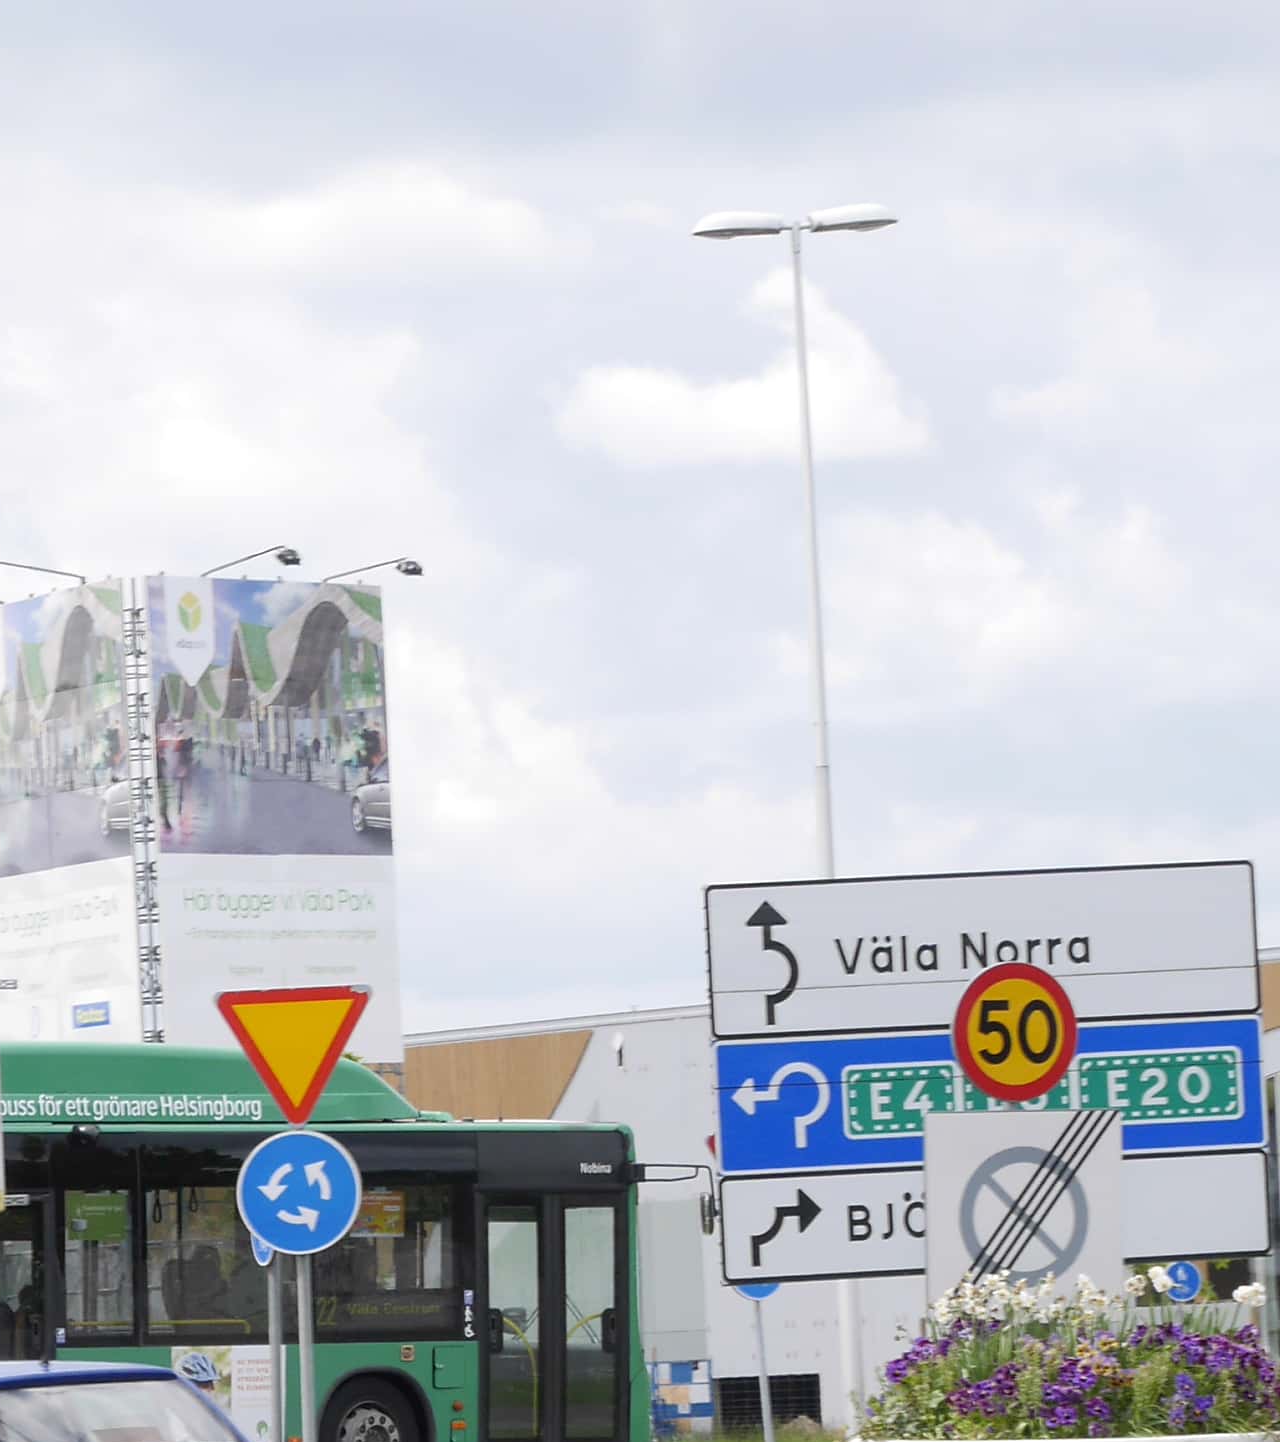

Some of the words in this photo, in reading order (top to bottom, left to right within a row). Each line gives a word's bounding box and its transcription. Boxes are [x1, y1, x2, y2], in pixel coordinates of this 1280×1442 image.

[216, 888, 277, 918] bygger
[338, 888, 376, 911] Park
[834, 935, 939, 975] Väla
[960, 931, 1090, 969] Norra
[978, 999, 1057, 1065] 50
[38, 1094, 61, 1117] för
[65, 1097, 90, 1117] ett
[93, 1096, 158, 1121] grönare
[160, 1094, 262, 1121] Helsingborg
[869, 1079, 933, 1121] E4
[1106, 1065, 1212, 1109] E20
[580, 1162, 612, 1174] Nobina
